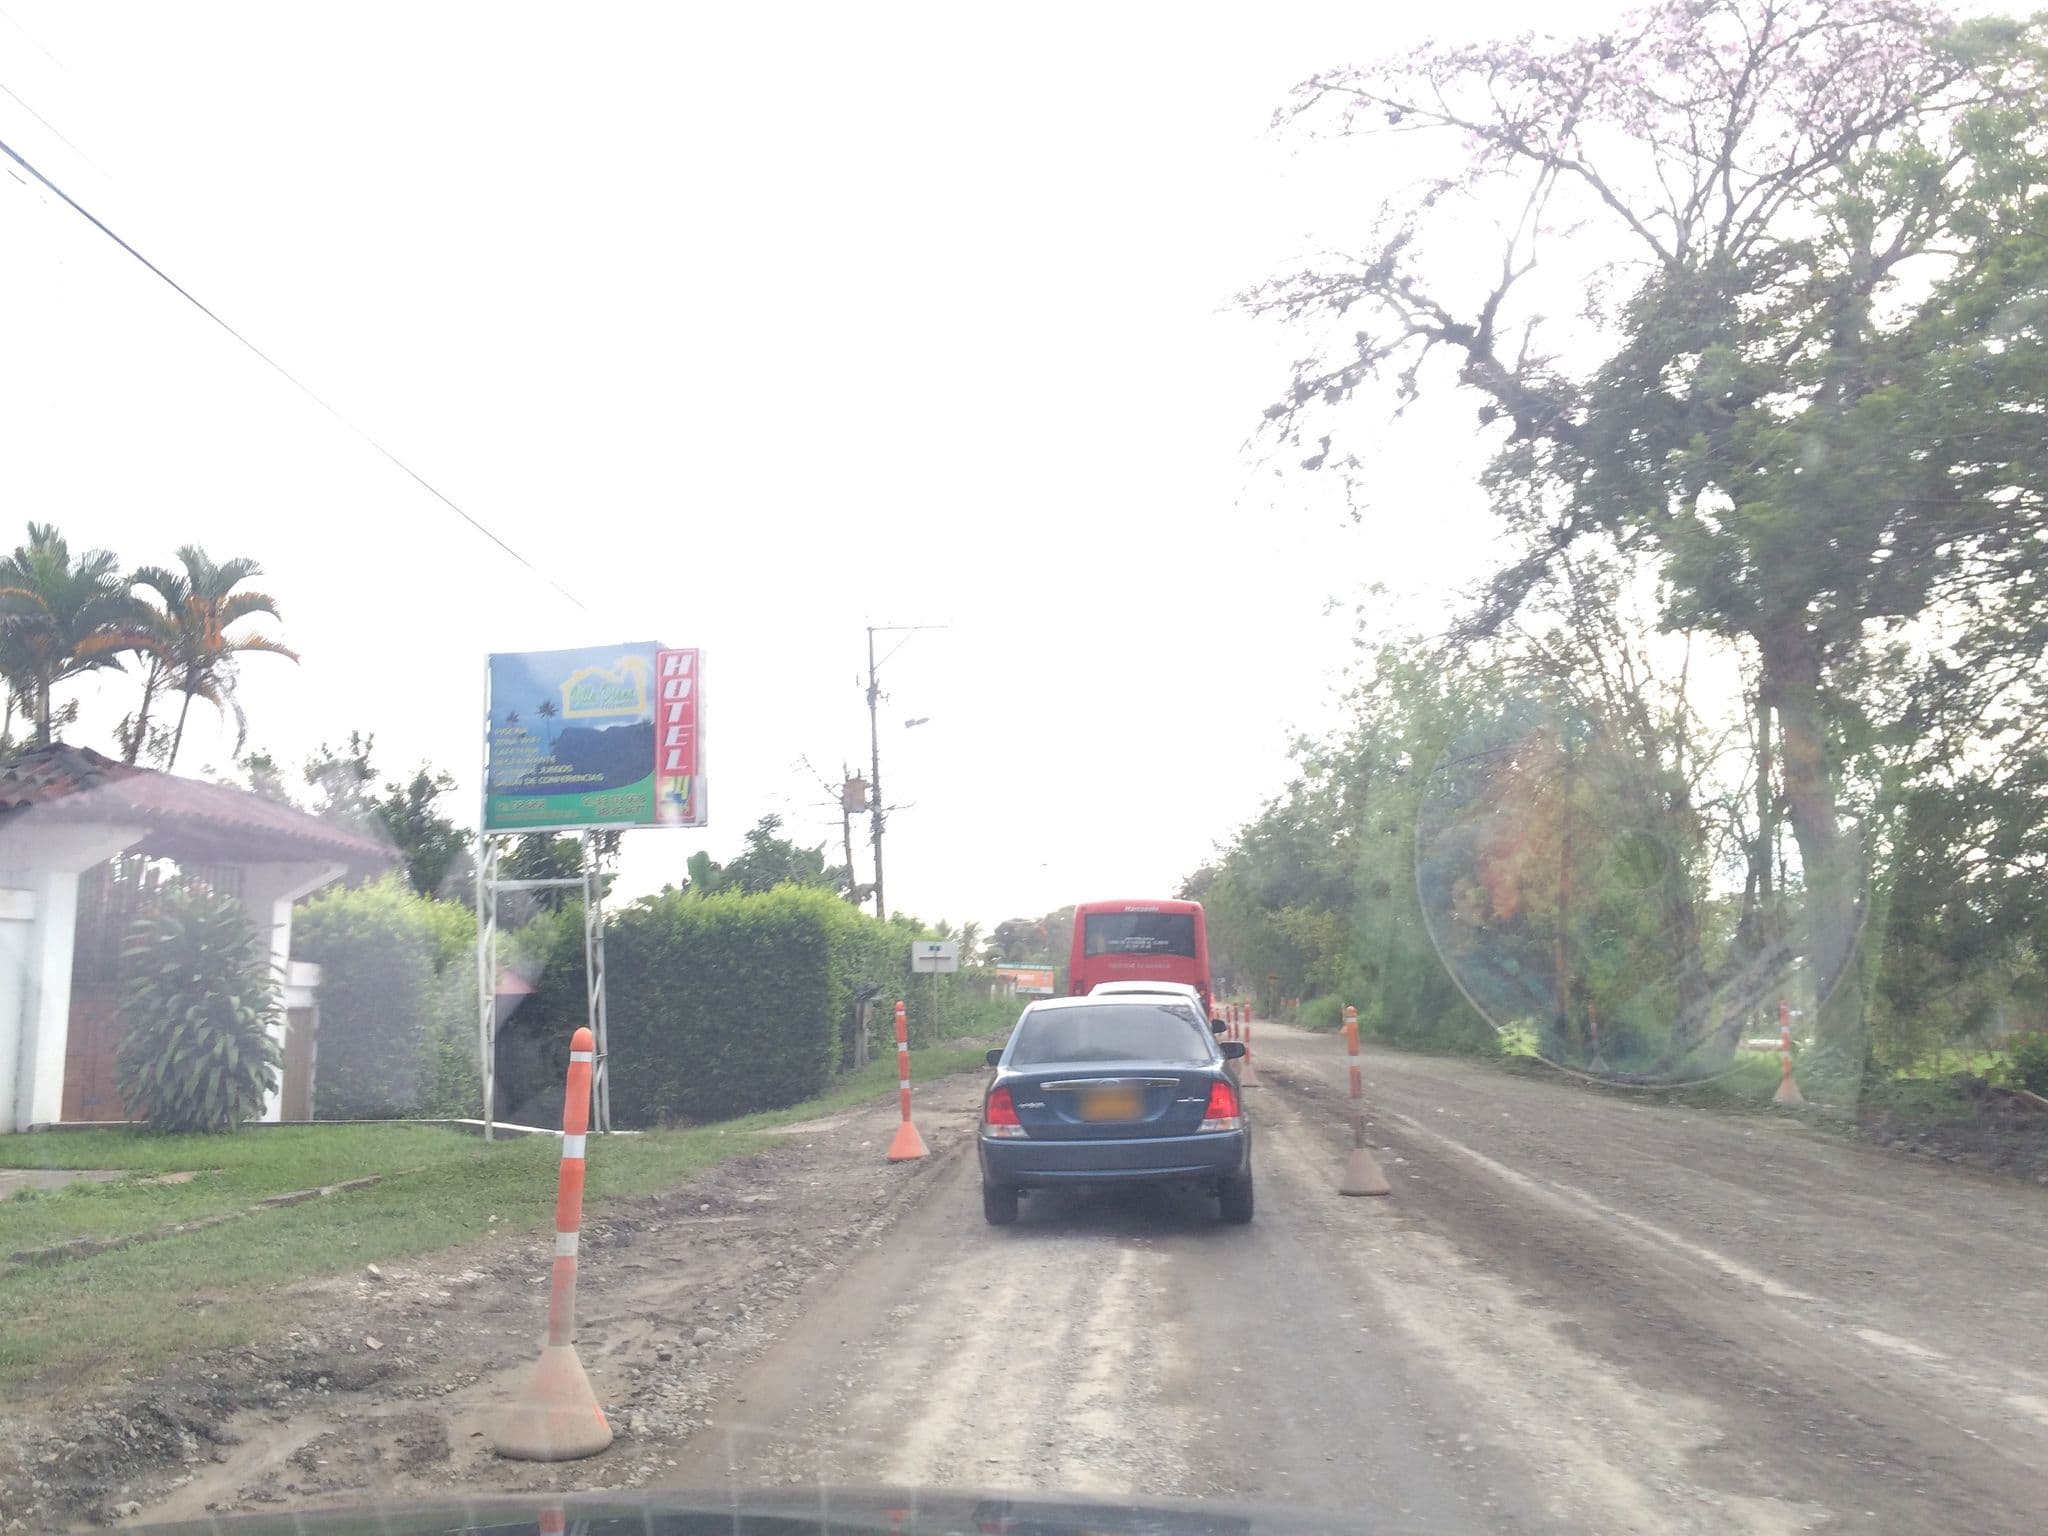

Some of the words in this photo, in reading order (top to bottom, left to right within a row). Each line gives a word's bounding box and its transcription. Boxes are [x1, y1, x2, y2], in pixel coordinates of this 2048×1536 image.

[662, 654, 693, 770] HOTEL
[540, 764, 574, 774] JUEGOS
[540, 773, 605, 784] CONFERENCIAS
